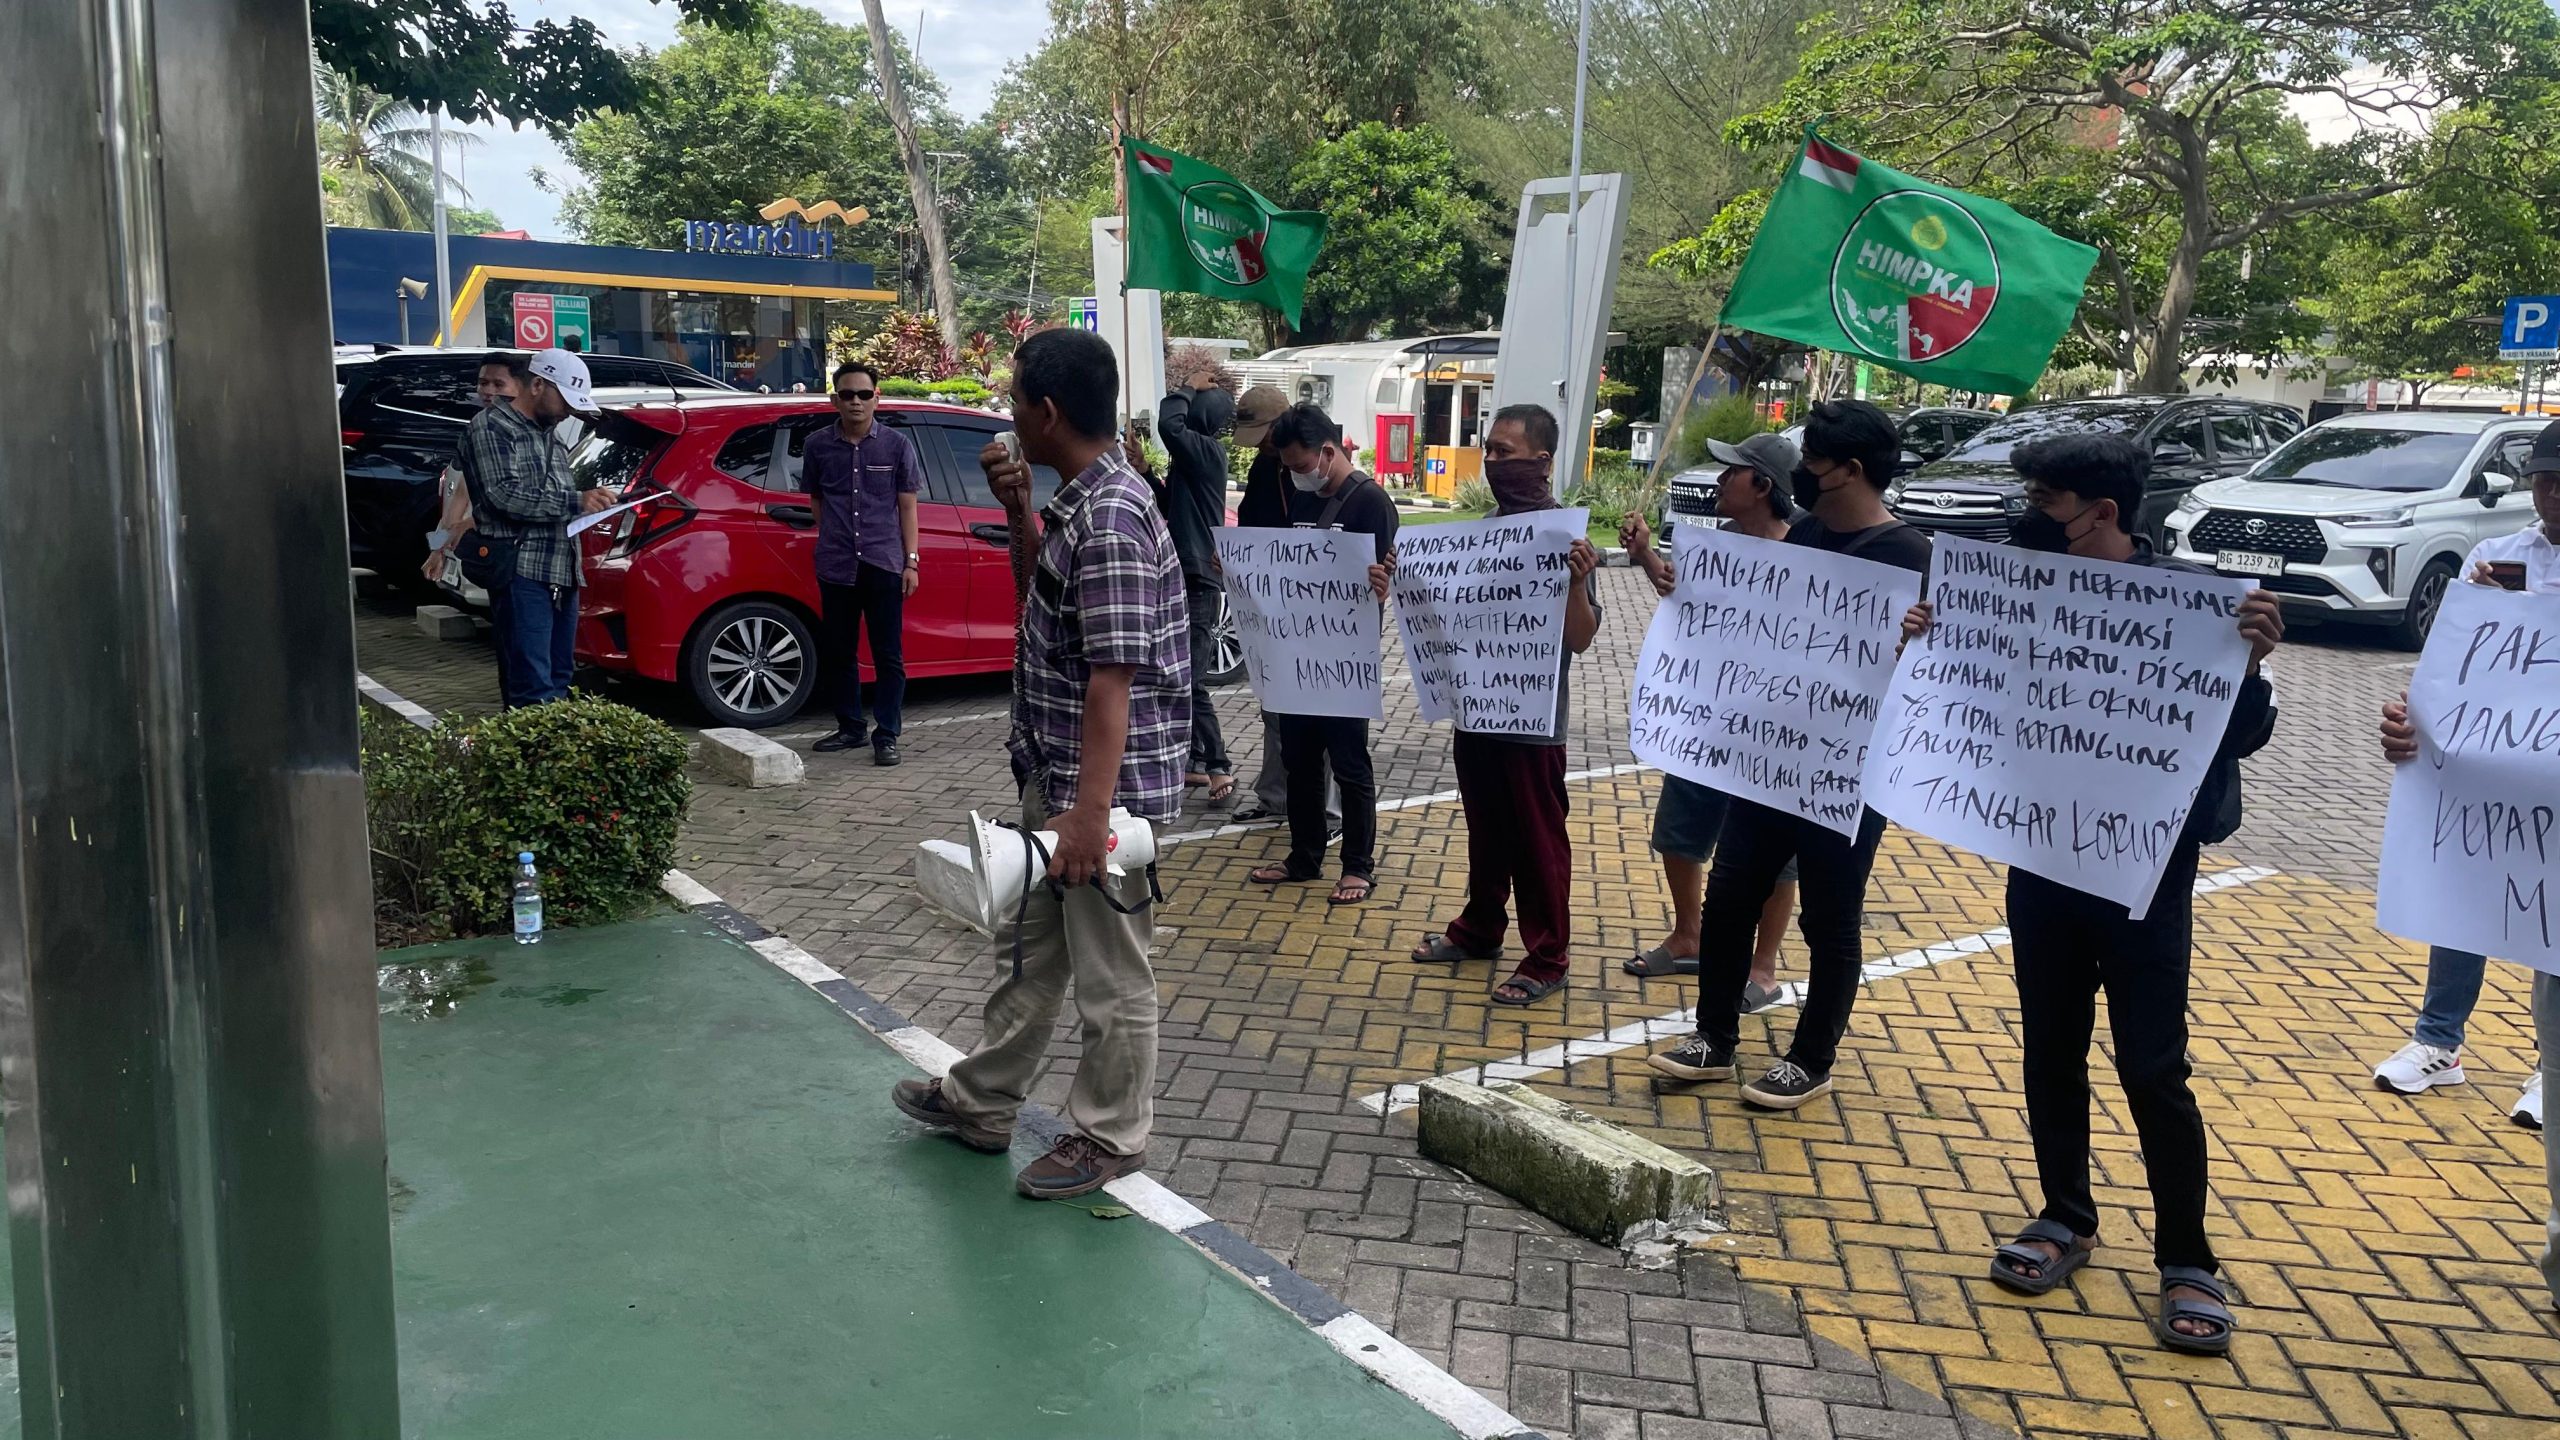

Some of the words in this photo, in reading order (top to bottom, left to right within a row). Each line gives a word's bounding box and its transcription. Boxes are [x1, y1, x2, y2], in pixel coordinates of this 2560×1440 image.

[685, 217, 833, 257] mandiri
[1856, 239, 1975, 310] HIMPKA
[555, 299, 586, 309] KELUAR
[2514, 302, 2549, 343] P
[1264, 539, 1337, 567] TUNTAS
[1397, 534, 1478, 558] MENDESAK
[1481, 524, 1534, 553] KEPALA
[2219, 552, 2233, 564] BG
[2236, 554, 2263, 567] 1239
[2267, 556, 2281, 570] ZK
[1465, 555, 1525, 576] CABANG
[1943, 542, 2056, 591] DITEMUKAN
[2068, 571, 2241, 618] MEKANISME
[1455, 578, 1523, 605] REGION
[1528, 580, 1542, 598] 2
[1679, 544, 1791, 601] TANGKAP
[1805, 574, 1891, 631] MAFIA
[1475, 633, 1556, 661] MANDIRI
[1926, 621, 2019, 660] REKENING
[2052, 605, 2174, 650] AKTIVASI
[1295, 651, 1379, 690] MANDIRI
[1651, 649, 1700, 689] DLM
[2458, 621, 2560, 686] PAK
[1463, 695, 1520, 717] PADANG
[1637, 683, 1712, 726] BANSOS
[1719, 707, 1809, 751] SEMBAKO
[1942, 698, 2006, 739] TIDAK
[2088, 687, 2194, 733] OKNUM
[2431, 700, 2560, 770] JANG
[2504, 872, 2552, 948] M
